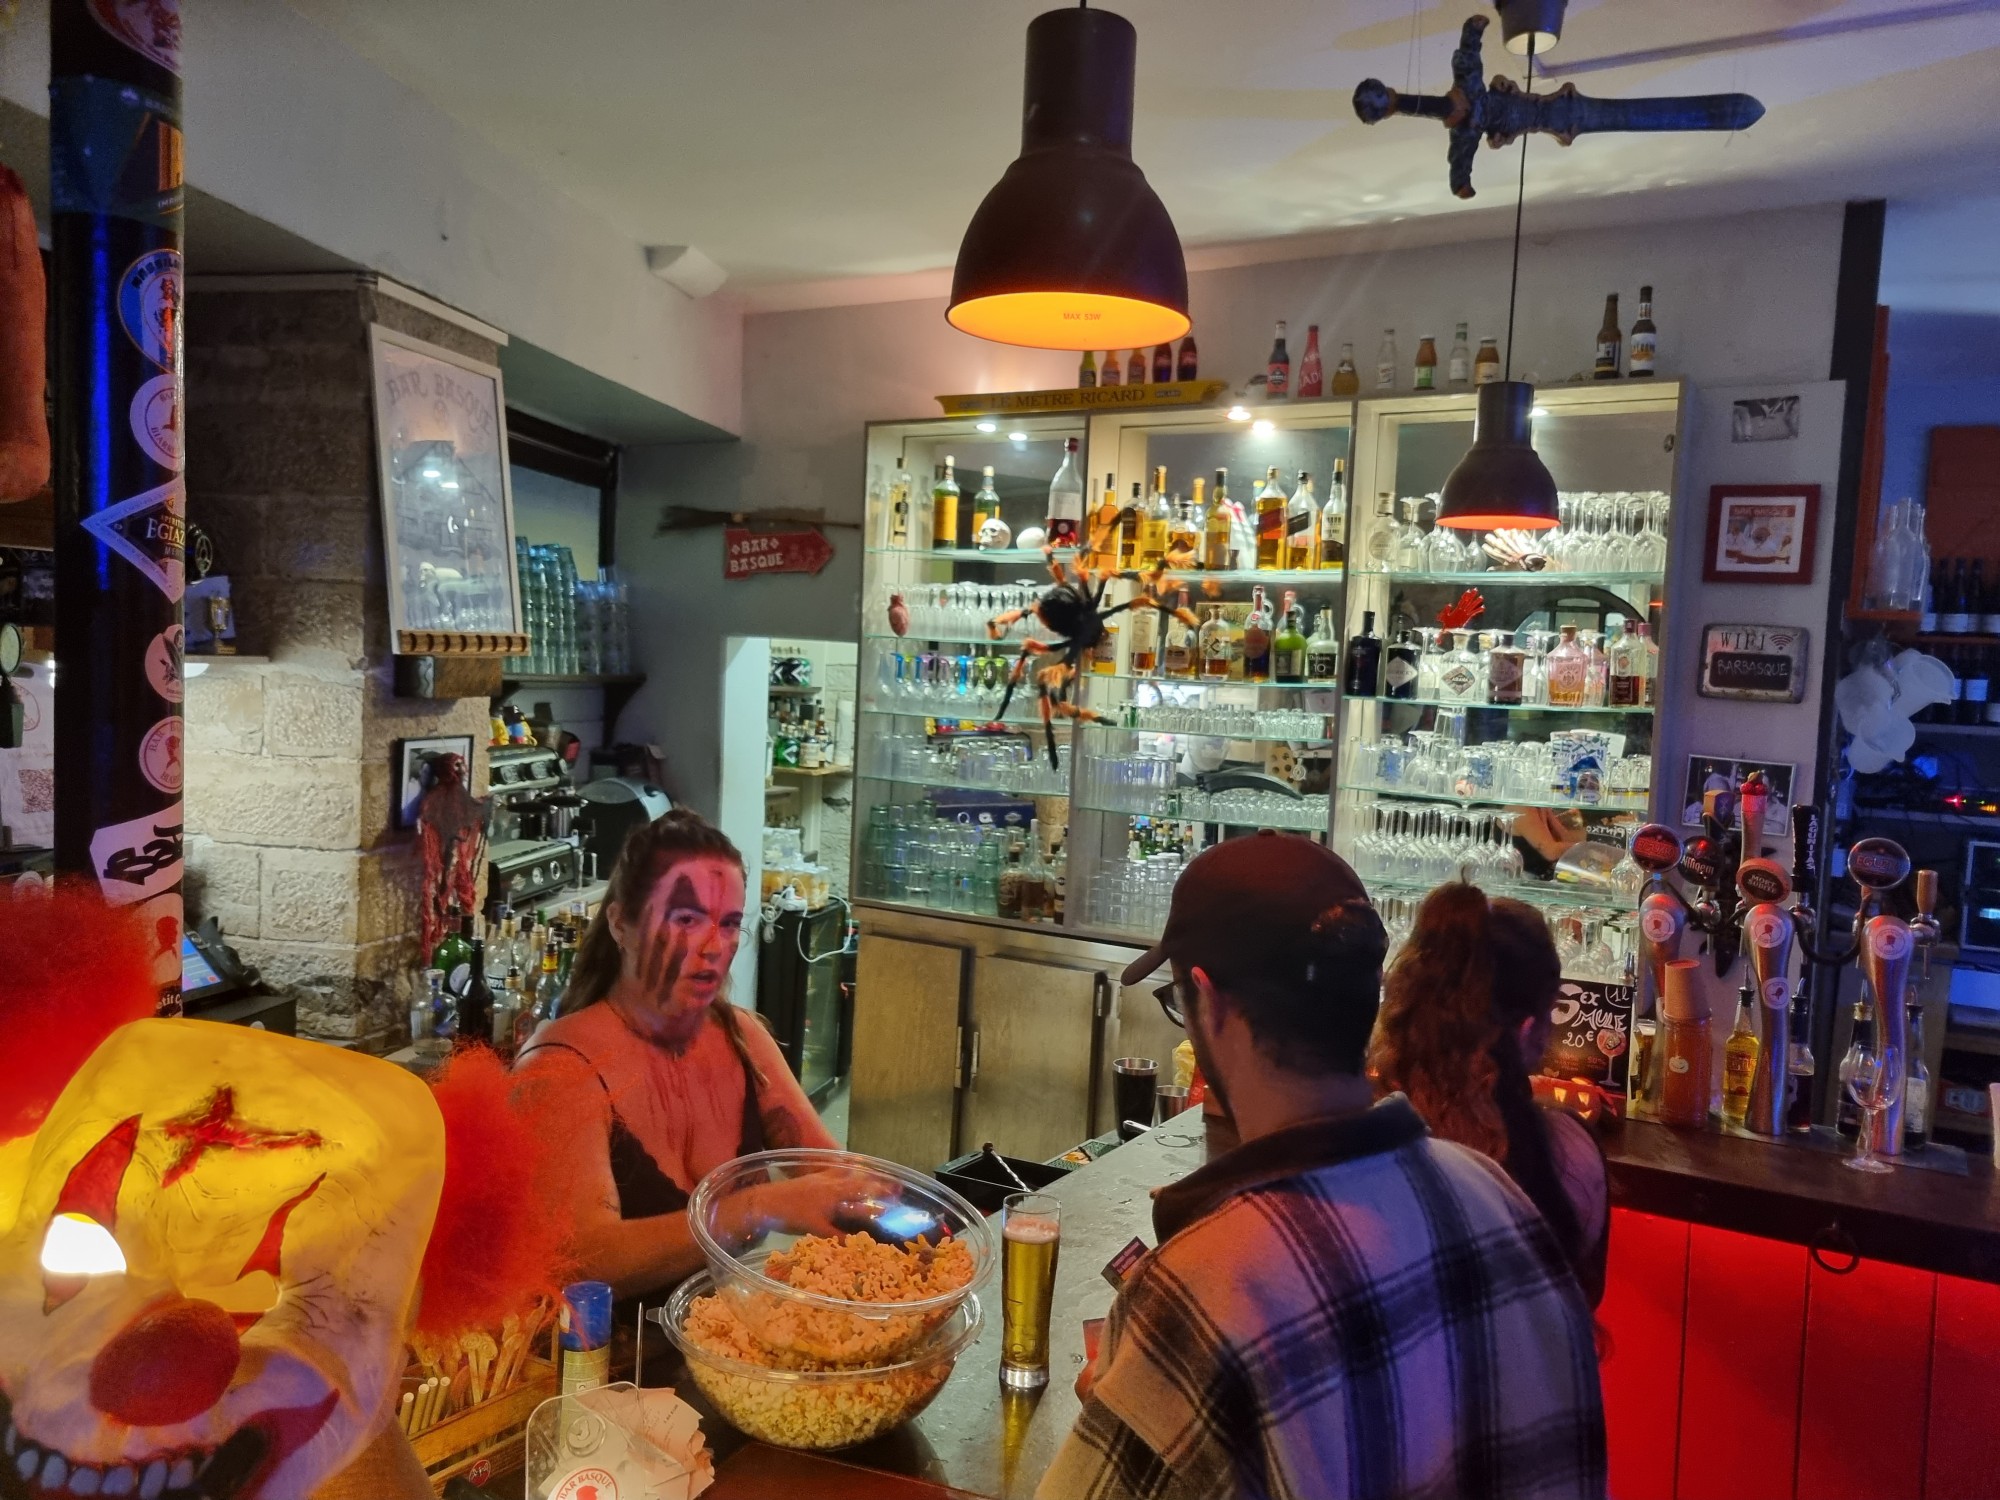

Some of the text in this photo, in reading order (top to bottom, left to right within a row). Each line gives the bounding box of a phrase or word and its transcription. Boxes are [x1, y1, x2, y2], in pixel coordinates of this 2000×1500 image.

[1062, 312, 1081, 321] MAX
[1079, 389, 1146, 405] RICARD
[741, 538, 769, 554] BAR
[729, 553, 784, 573] BASQUE
[1720, 632, 1766, 651] WIFI
[1717, 658, 1789, 677] BARBASQUE
[1805, 813, 1819, 871] LAGUNITAS
[1751, 873, 1778, 888] MORT
[1571, 1008, 1627, 1032] MULE
[1562, 1030, 1595, 1048] 20€
[559, 1472, 612, 1500] BAR BASQUE
